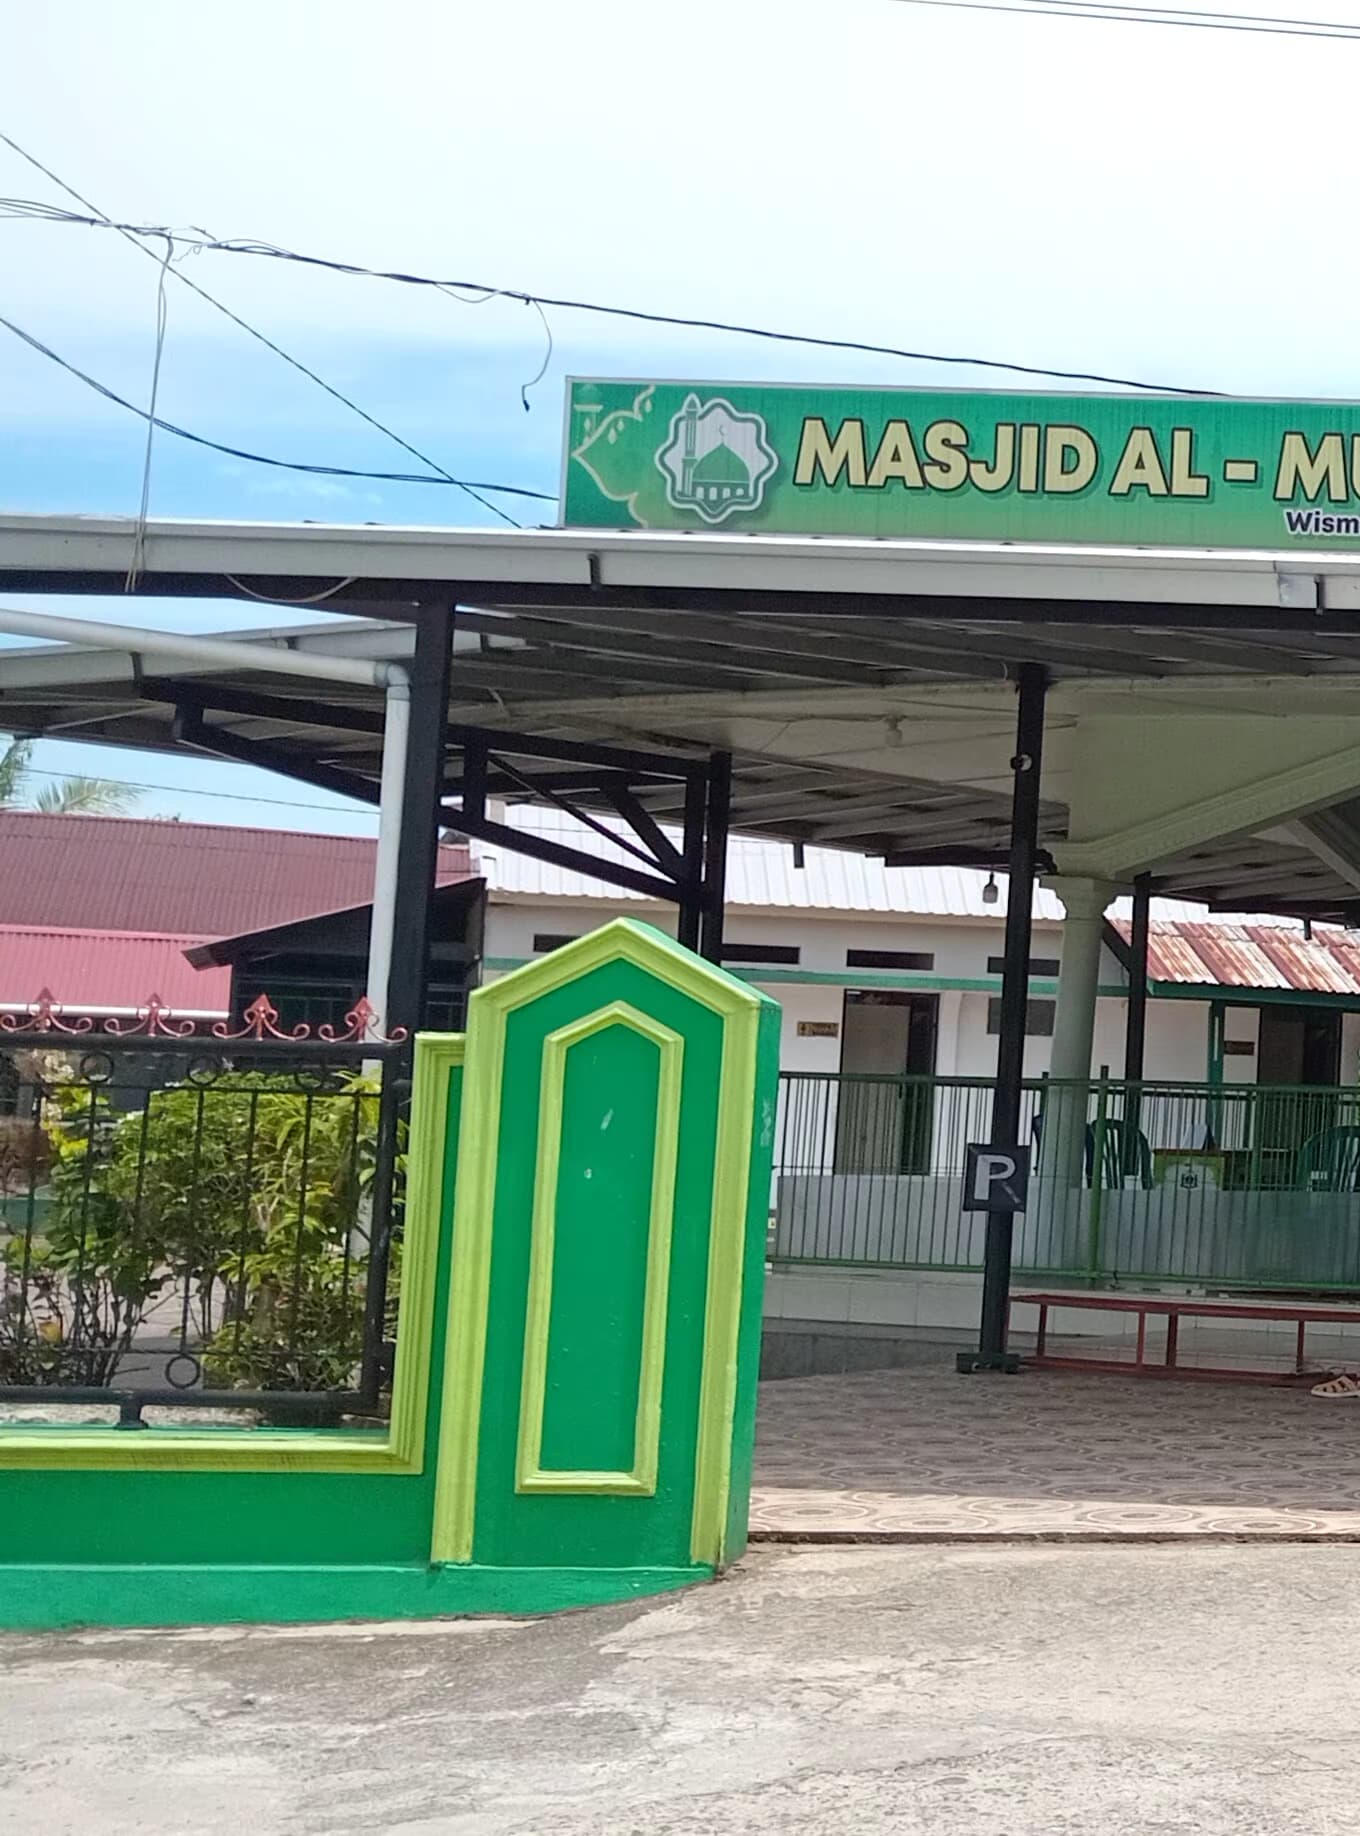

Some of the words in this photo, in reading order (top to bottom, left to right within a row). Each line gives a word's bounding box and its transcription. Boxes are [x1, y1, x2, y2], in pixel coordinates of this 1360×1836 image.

[794, 417, 1098, 493] MASJID
[1109, 427, 1209, 496] AL
[1224, 460, 1258, 482] -
